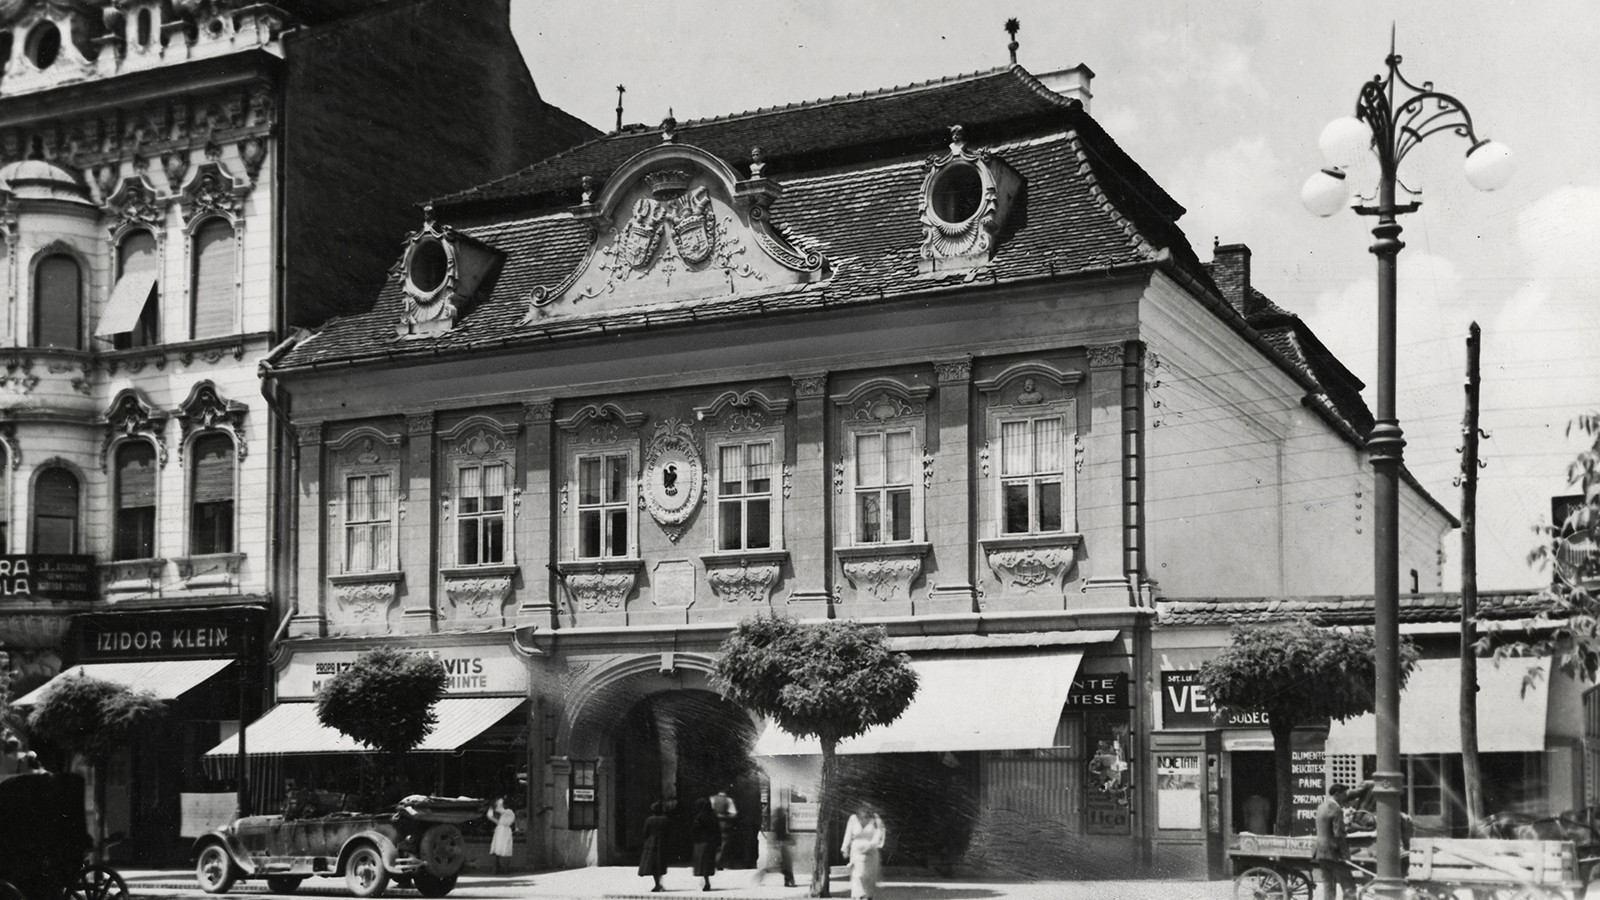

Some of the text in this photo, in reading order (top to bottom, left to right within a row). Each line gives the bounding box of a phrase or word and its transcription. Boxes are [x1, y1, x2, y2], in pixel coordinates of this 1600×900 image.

[97, 627, 229, 650] IZIDOR KLEIN
[439, 657, 484, 675] VITS
[445, 675, 488, 690] MINTE
[1071, 678, 1115, 690] NTE
[1167, 685, 1217, 713] VE
[1228, 711, 1271, 724] ODEG
[1297, 809, 1318, 820] FRUC
